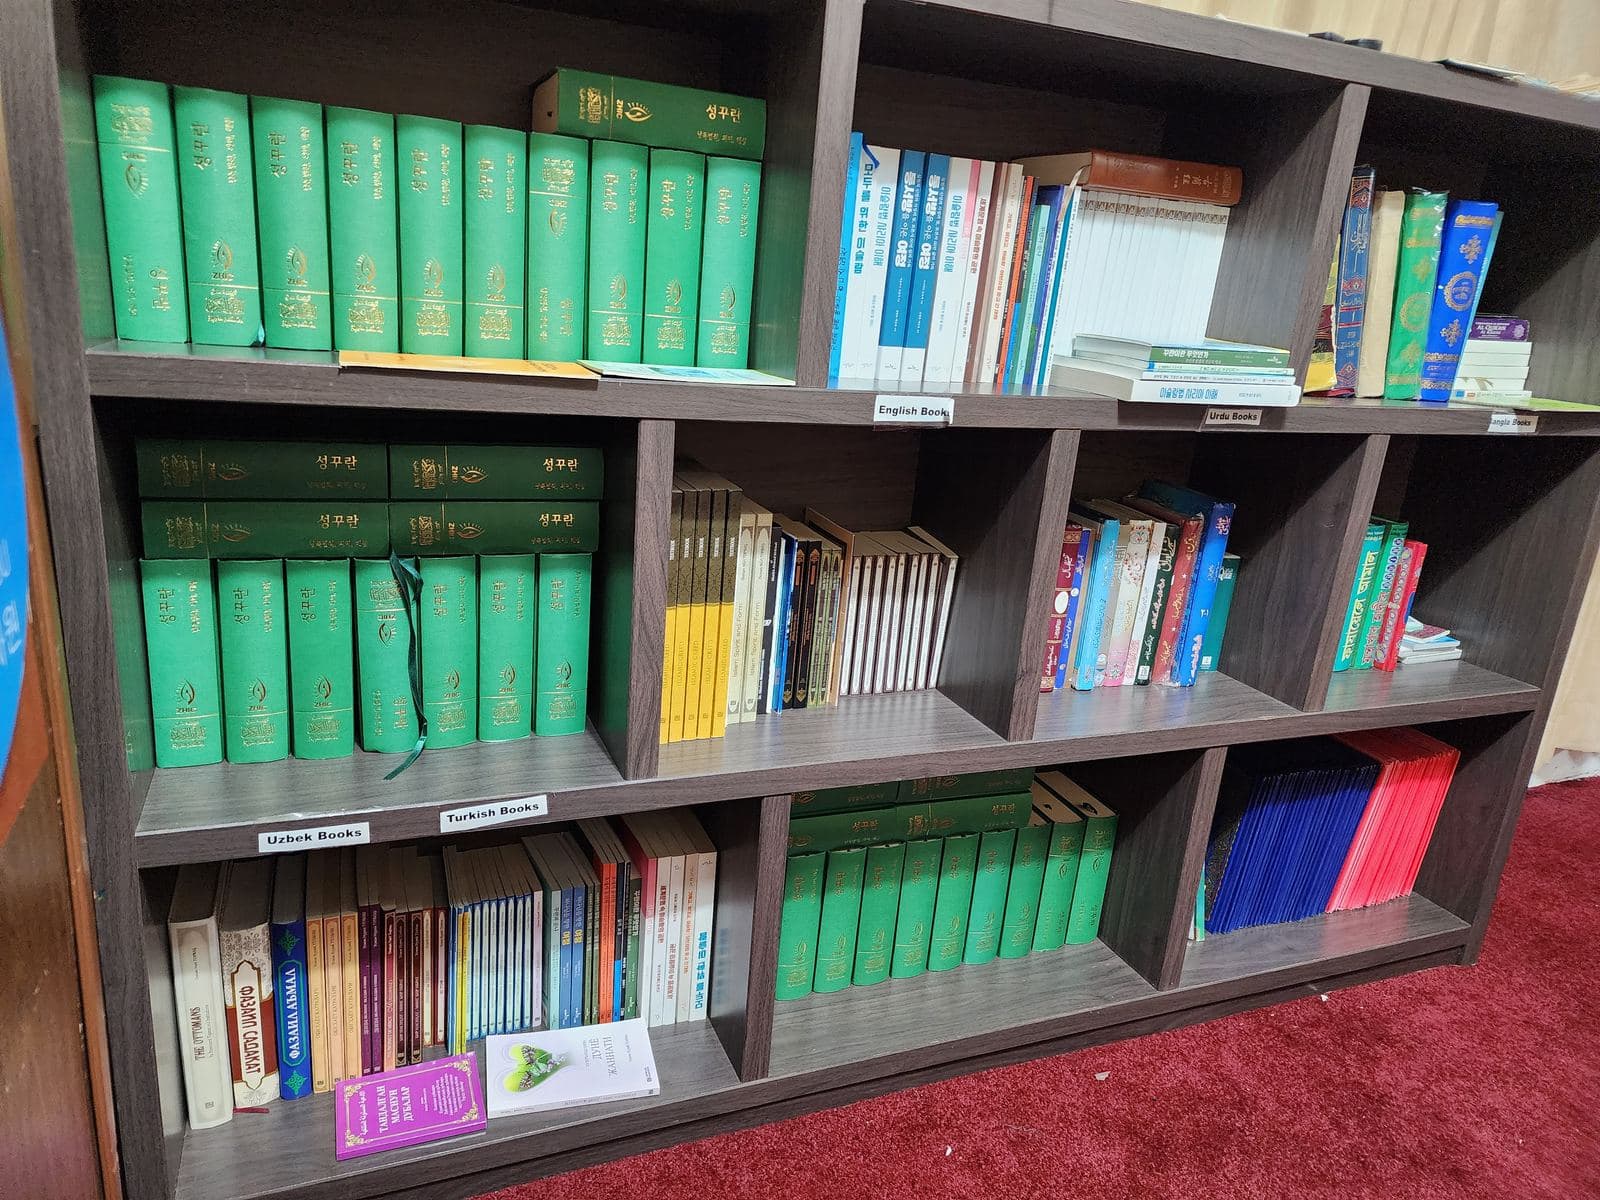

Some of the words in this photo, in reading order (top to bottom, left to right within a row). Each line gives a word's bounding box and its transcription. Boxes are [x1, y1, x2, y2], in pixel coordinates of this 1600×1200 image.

[705, 103, 742, 124] 성꾸란
[901, 171, 917, 222] 동서방을
[925, 174, 941, 223] 동서방을
[857, 206, 869, 234] 위한
[873, 249, 885, 267] 이해
[894, 239, 908, 269] 여정
[918, 242, 933, 271] 여정
[943, 255, 957, 273] 이해
[879, 405, 918, 416] English
[1209, 412, 1230, 420] Urdu
[1232, 413, 1258, 421] Books
[1492, 418, 1511, 427] angla
[1512, 418, 1531, 426] Books
[315, 453, 358, 471] 성꾸란
[543, 457, 579, 473] 성꾸란
[319, 512, 359, 529] 성꾸란
[538, 511, 575, 528] 성꾸란
[157, 587, 176, 625] 성꾸란
[234, 586, 250, 624] 성꾸란
[301, 586, 317, 624] 성꾸란
[447, 808, 496, 823] Turkish
[500, 802, 539, 816] Books
[267, 833, 313, 846] Uzbek
[318, 828, 362, 841] Books
[287, 967, 297, 1010] АЪМАЛ
[189, 1006, 204, 1046] OTTOMANS
[288, 1010, 299, 1059] ФАЗАИЛ
[193, 1046, 206, 1062] THE
[242, 1030, 262, 1074] САДАКАТ
[391, 1088, 399, 1124] МАСНУН
[402, 1086, 414, 1122] ДУБАЛАР
